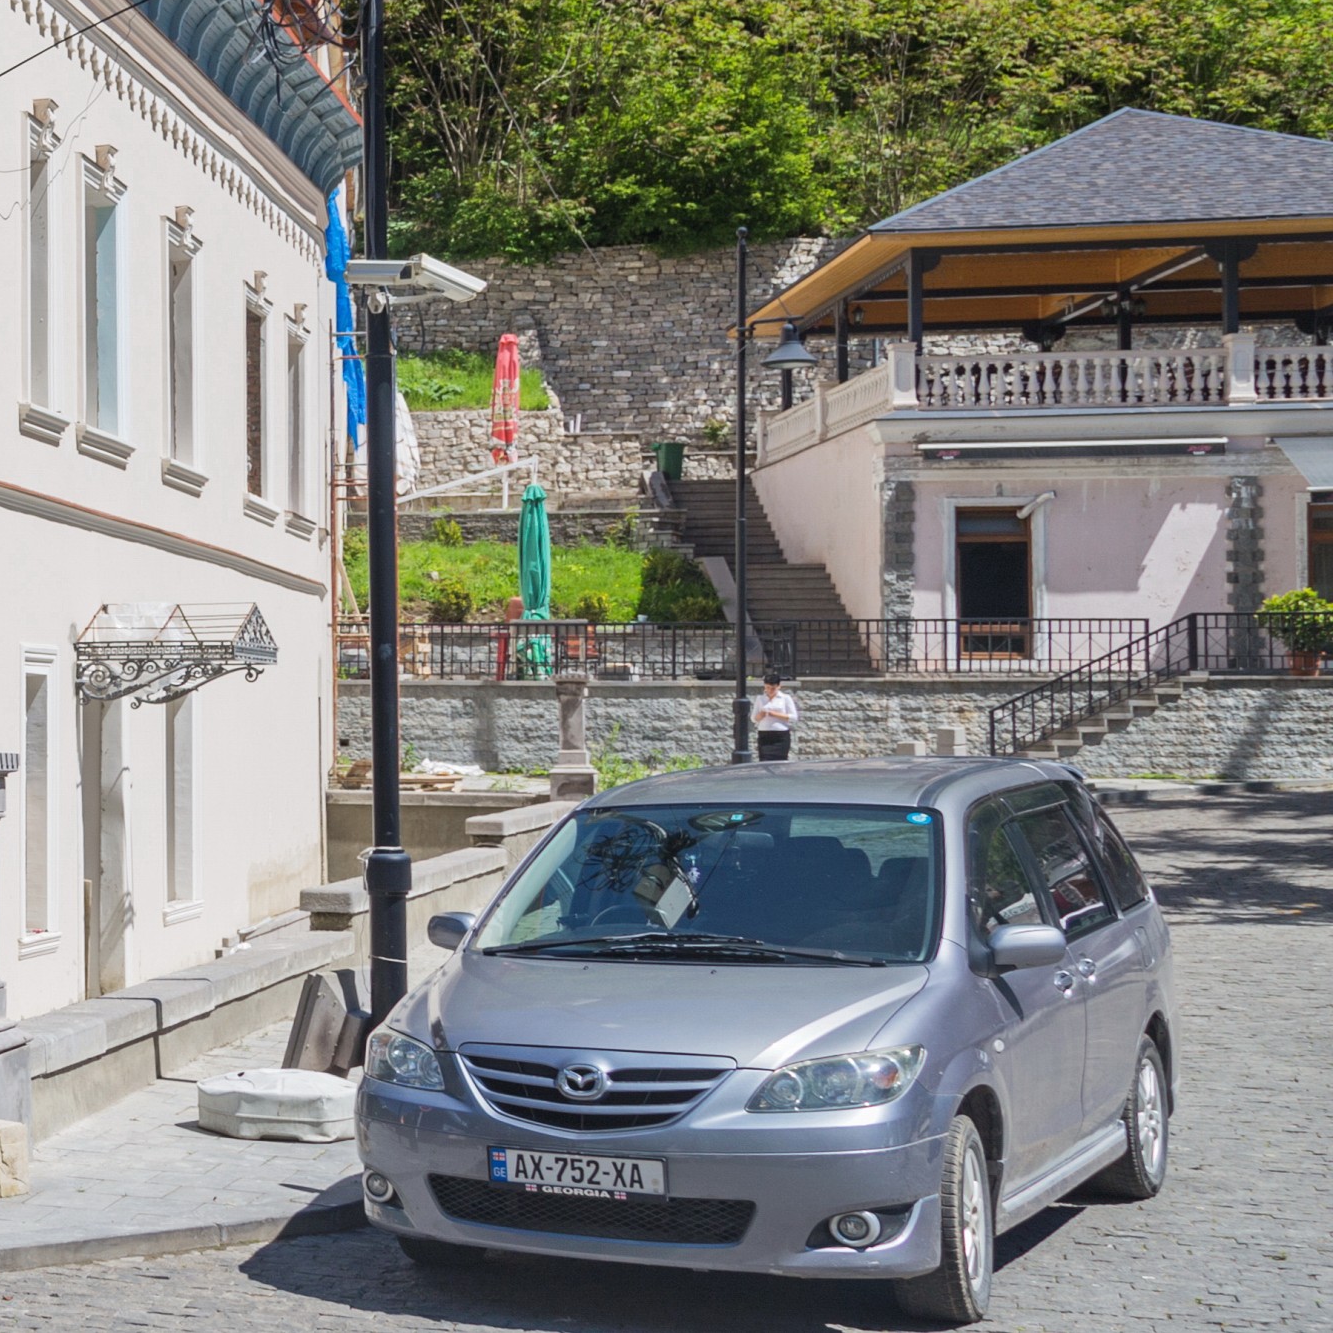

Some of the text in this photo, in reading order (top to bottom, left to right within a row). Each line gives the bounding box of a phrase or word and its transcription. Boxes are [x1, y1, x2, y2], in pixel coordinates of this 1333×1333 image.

[493, 1166, 507, 1178] GE
[514, 1153, 645, 1190] AX-752-XA
[541, 1185, 611, 1199] GEORGIA
